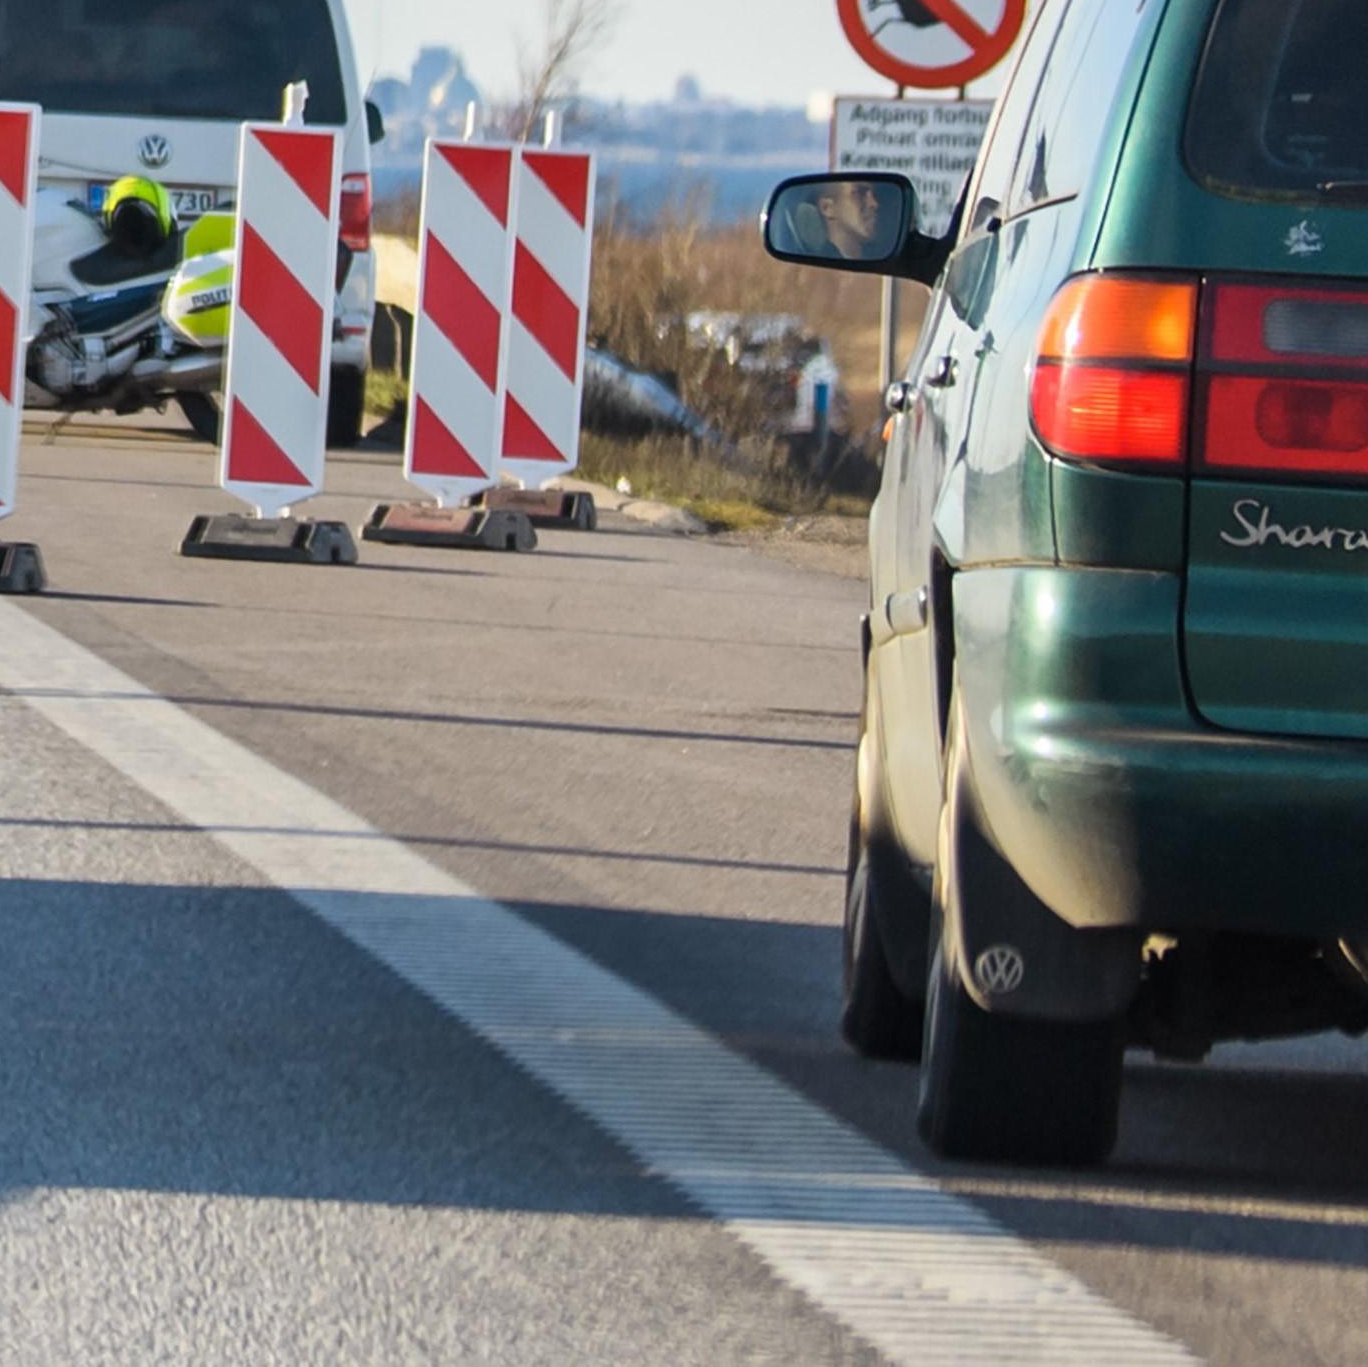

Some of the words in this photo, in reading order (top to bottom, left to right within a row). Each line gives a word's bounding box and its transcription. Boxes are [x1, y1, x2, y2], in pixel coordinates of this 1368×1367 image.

[849, 103, 928, 127] Adgang
[934, 106, 990, 124] forbu
[856, 128, 916, 145] Privat
